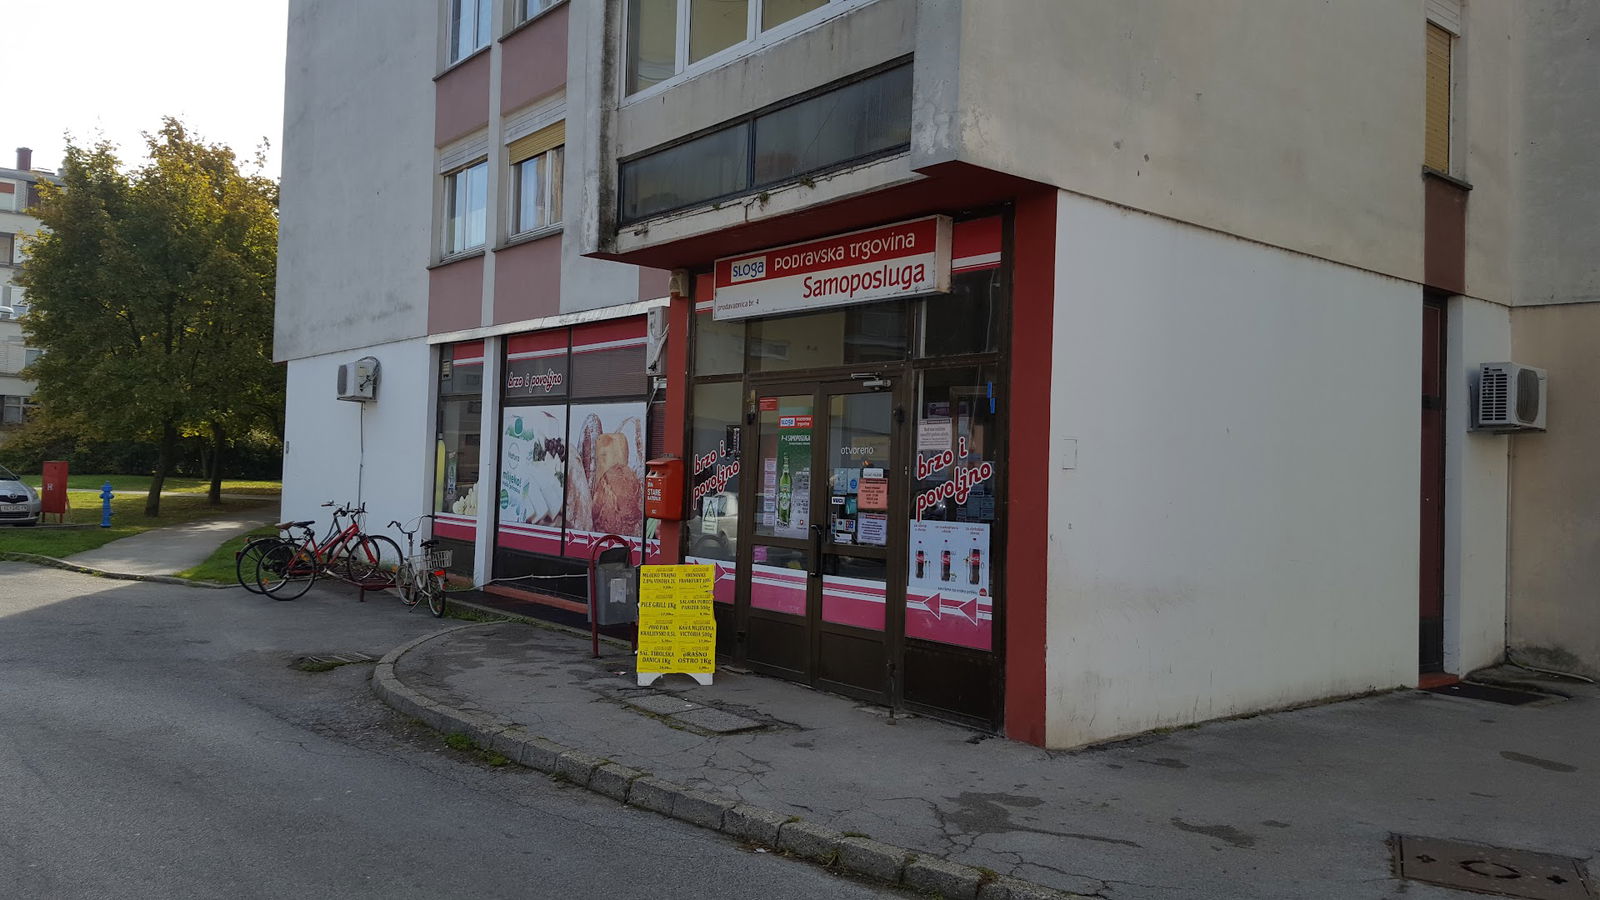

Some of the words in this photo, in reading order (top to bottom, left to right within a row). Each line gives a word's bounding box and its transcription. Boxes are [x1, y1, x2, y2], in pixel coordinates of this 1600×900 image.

[850, 232, 915, 260] trgovina
[803, 263, 925, 298] Samoposluga
[508, 371, 523, 388] brzo
[524, 373, 530, 387] i
[529, 368, 562, 393] povoljno
[694, 449, 717, 475] brzo
[720, 439, 726, 458] i
[840, 446, 874, 455] otvoreno
[917, 449, 954, 480] brzo
[959, 436, 968, 459] i
[647, 488, 662, 496] STARE
[692, 461, 740, 511] povoljno
[915, 462, 992, 523] povoljno
